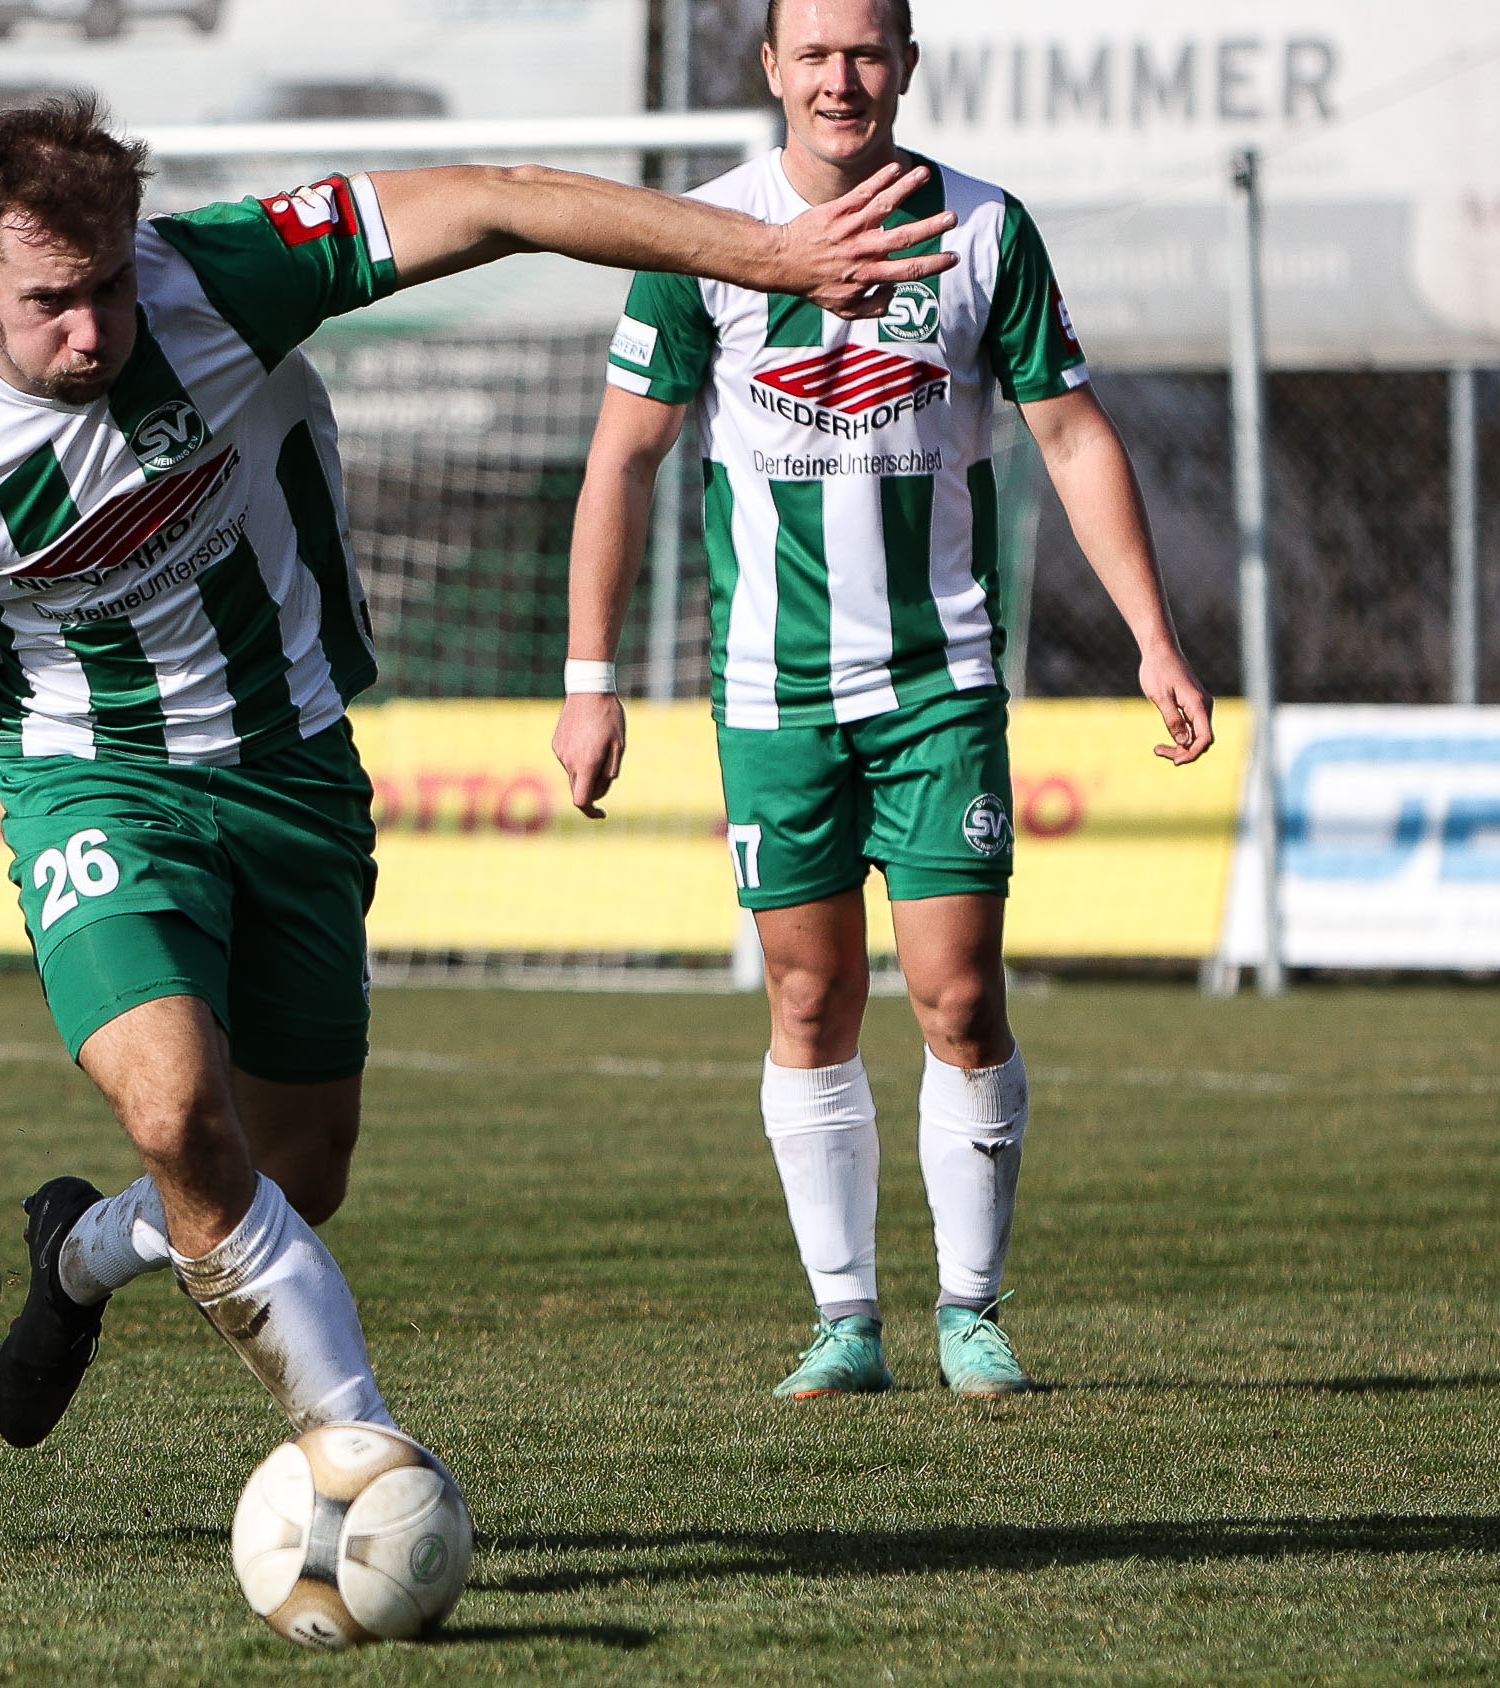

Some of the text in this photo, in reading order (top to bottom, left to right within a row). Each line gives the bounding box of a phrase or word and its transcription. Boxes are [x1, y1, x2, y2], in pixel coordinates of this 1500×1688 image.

[920, 33, 1341, 127] WIMMER
[880, 297, 938, 327] SV
[138, 406, 196, 462] SV
[750, 380, 948, 440] NIEDERHOFER
[753, 446, 944, 477] DerfeineUnterschied
[33, 828, 120, 932] 26
